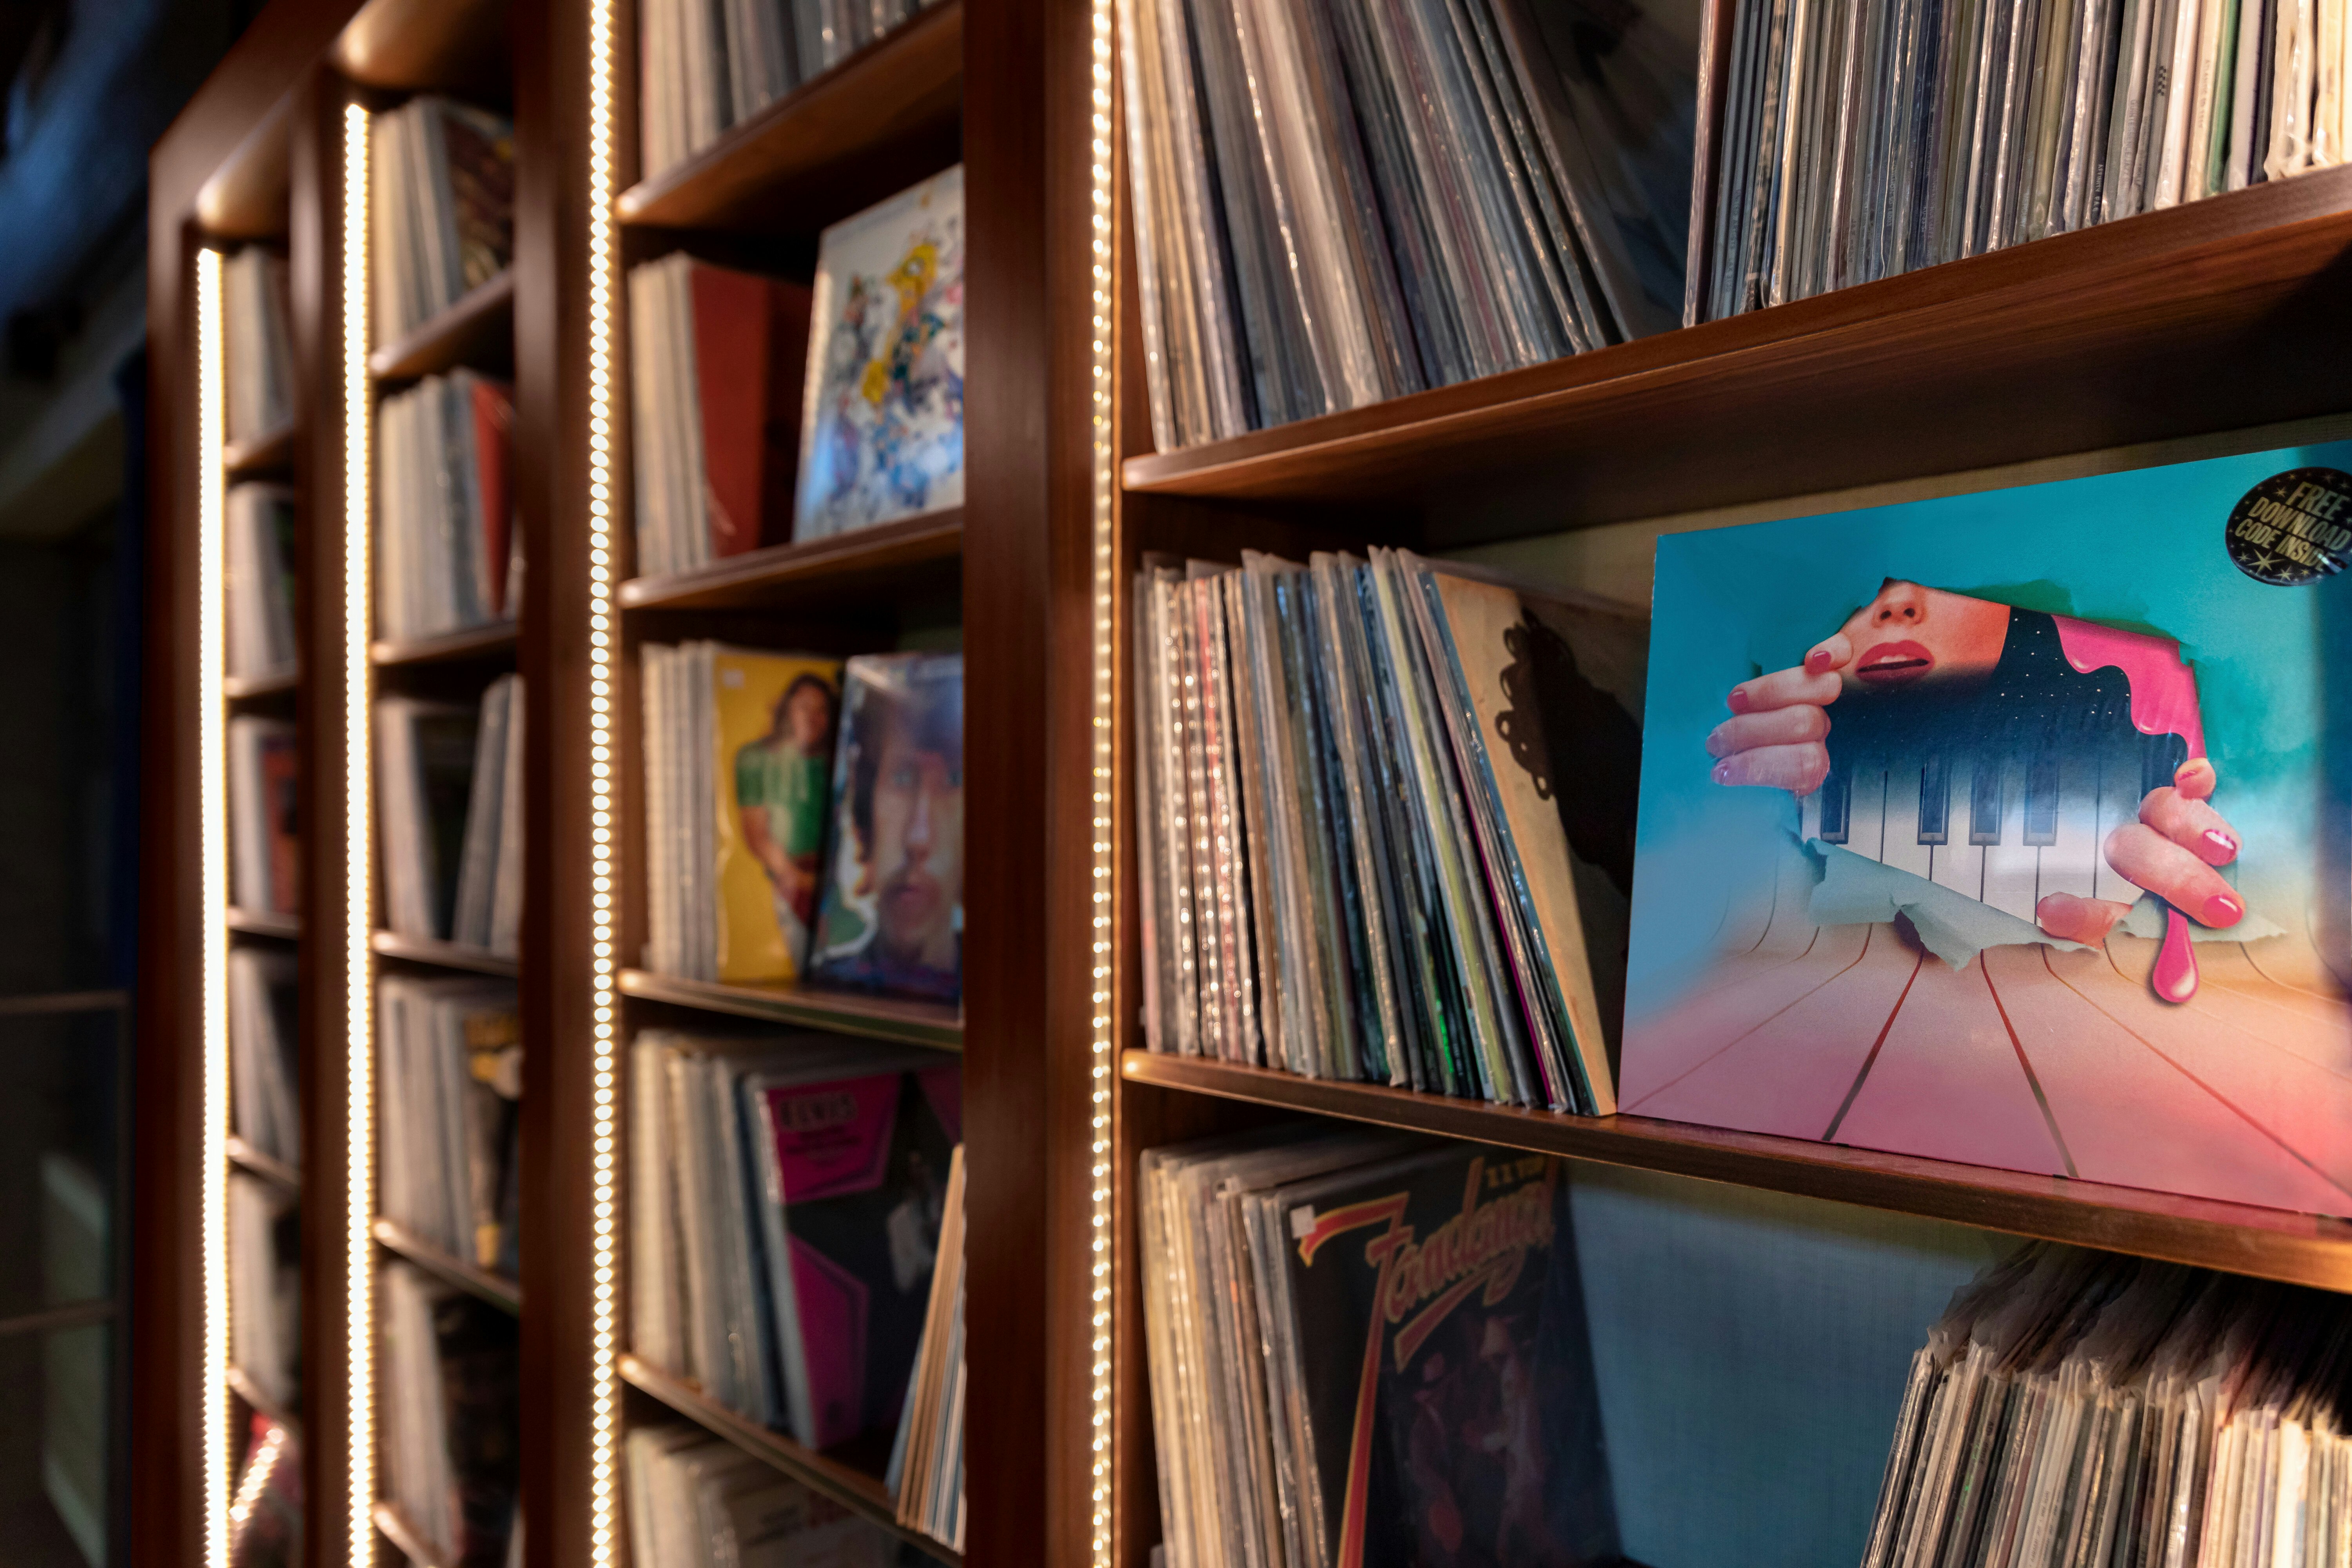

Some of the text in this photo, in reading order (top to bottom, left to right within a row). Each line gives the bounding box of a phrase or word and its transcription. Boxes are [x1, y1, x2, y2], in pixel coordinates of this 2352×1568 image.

[2095, 164, 2103, 192] AFFINITY
[2247, 496, 2352, 551] DOWNLOAD
[2285, 481, 2351, 522] FREE
[2235, 518, 2336, 572] CODE INSIDE
